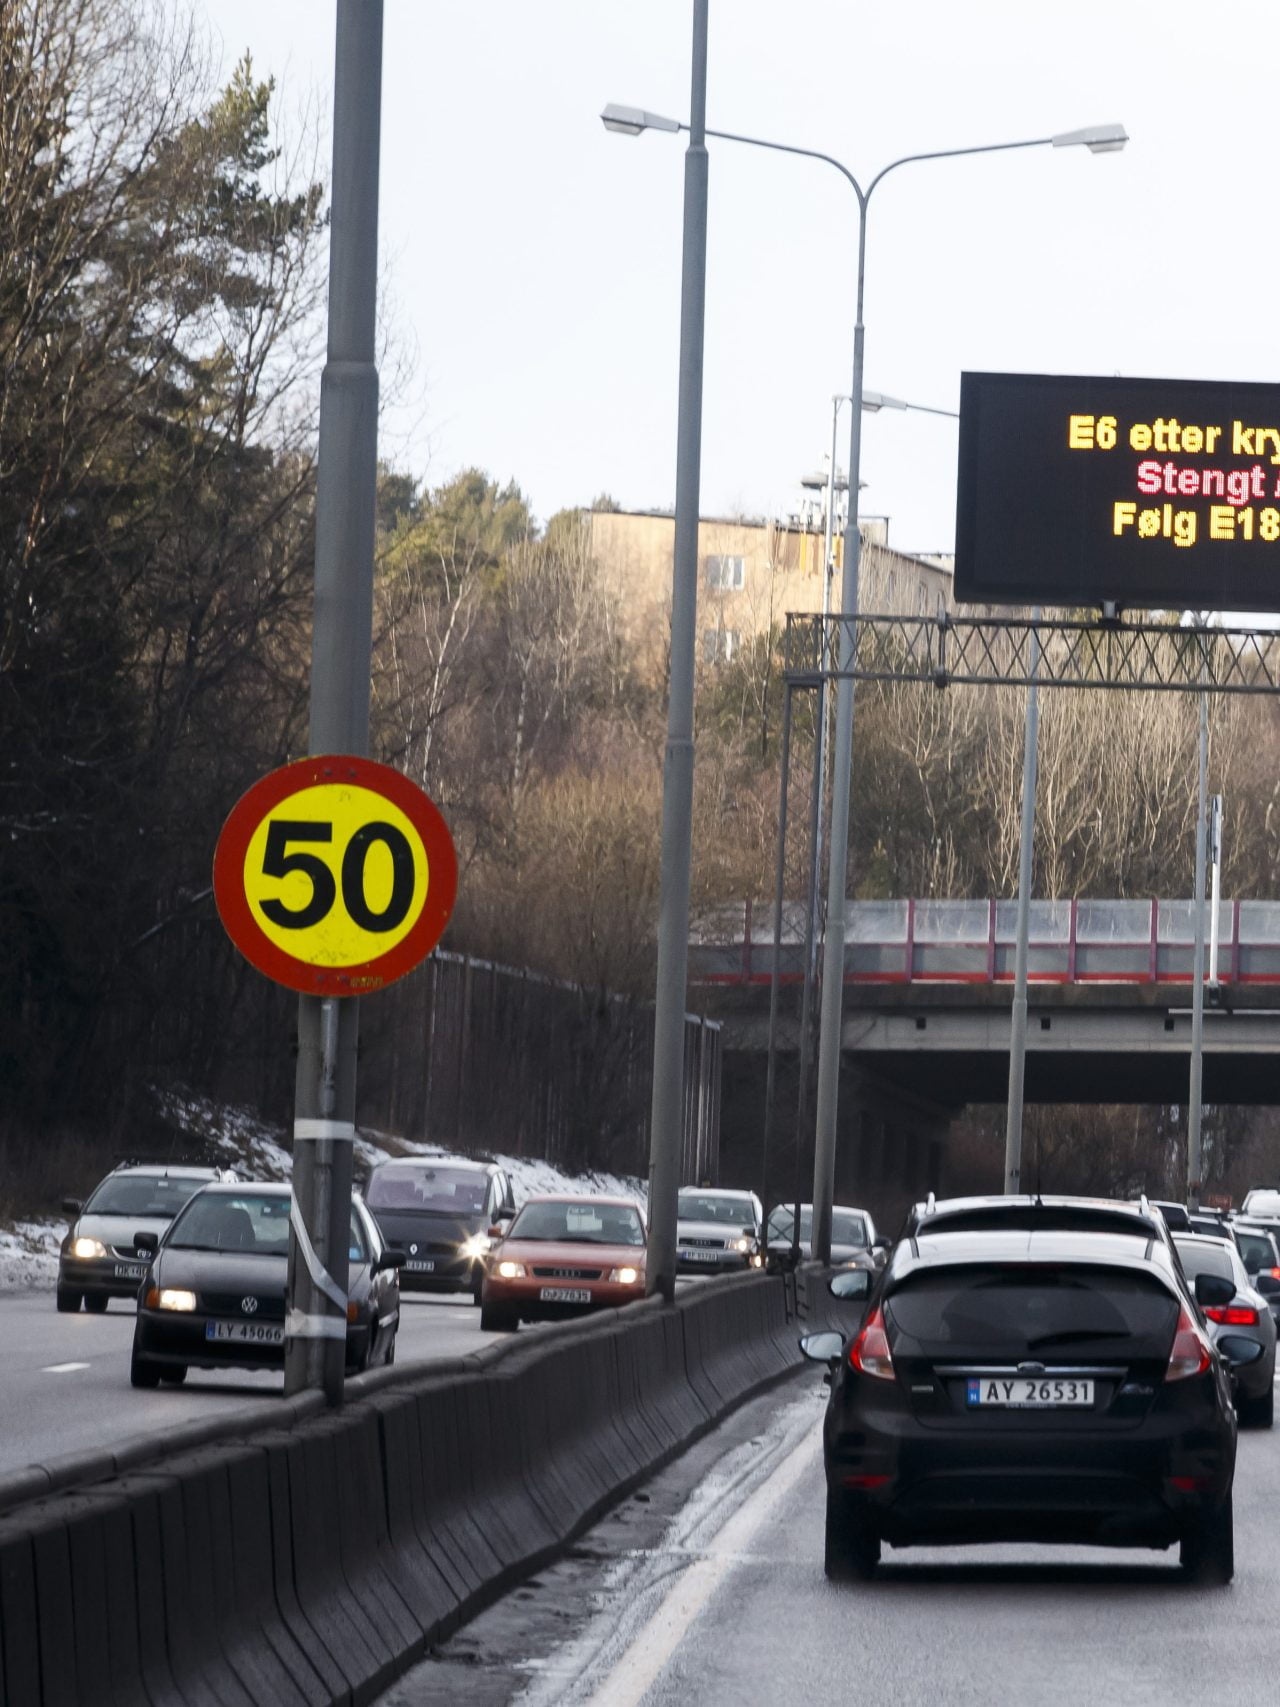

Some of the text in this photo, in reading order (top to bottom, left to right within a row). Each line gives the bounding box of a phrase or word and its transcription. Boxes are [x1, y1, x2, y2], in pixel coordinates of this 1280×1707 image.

[1069, 415, 1117, 450] E6
[1129, 418, 1222, 453] etter
[1137, 460, 1266, 506] Stengt
[1113, 502, 1197, 547] Følg
[1210, 505, 1280, 541] E18
[258, 819, 416, 934] 50
[217, 1322, 234, 1338] LY
[986, 1382, 1089, 1401] AY 26531
